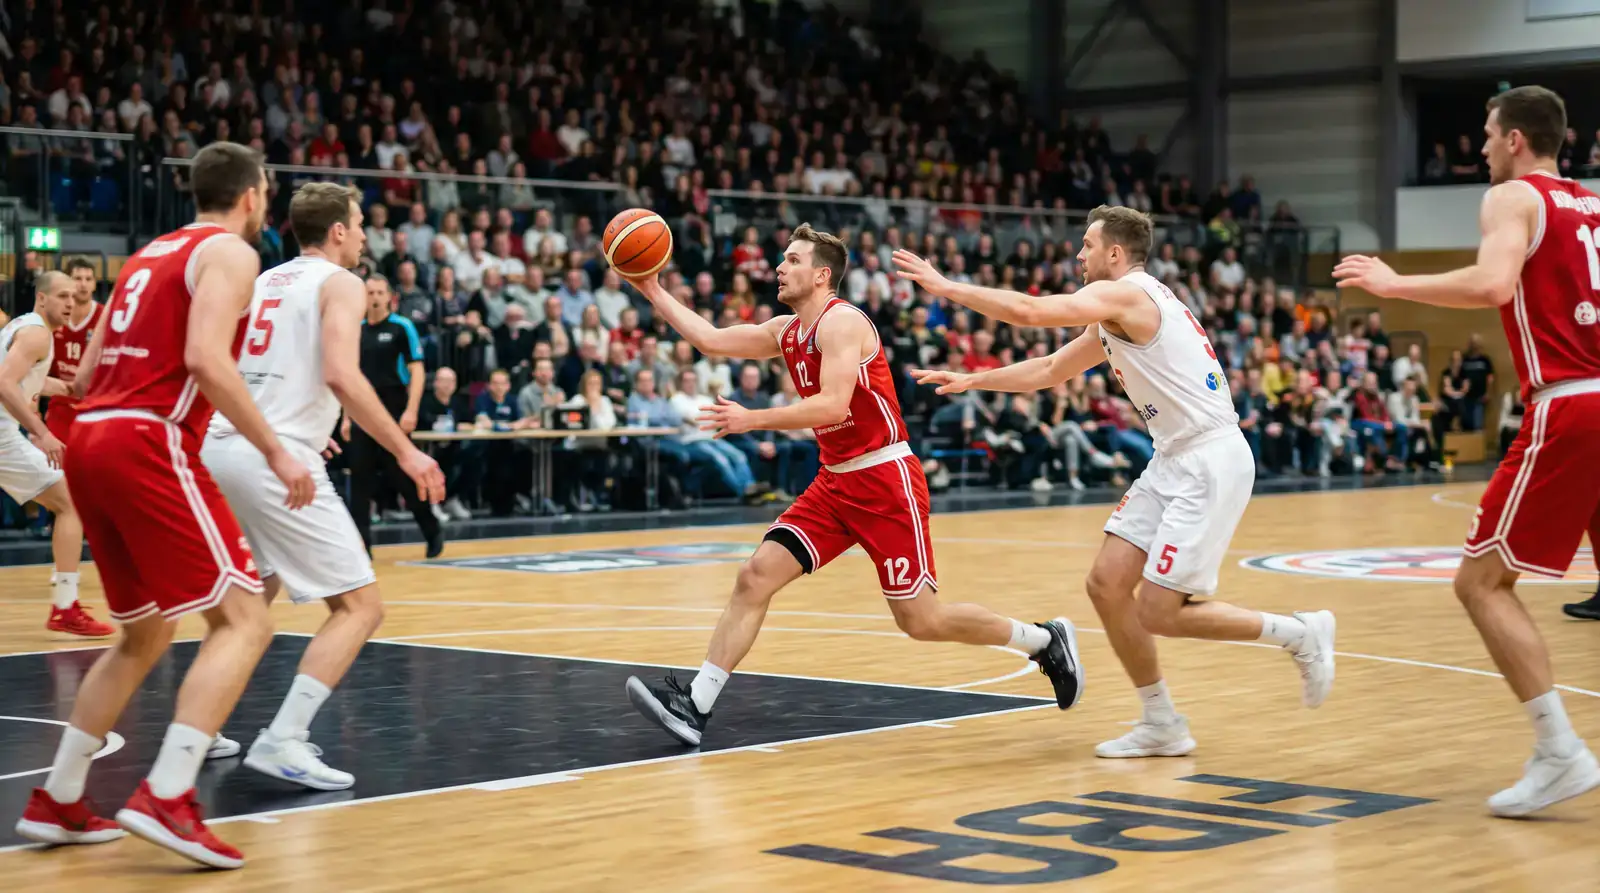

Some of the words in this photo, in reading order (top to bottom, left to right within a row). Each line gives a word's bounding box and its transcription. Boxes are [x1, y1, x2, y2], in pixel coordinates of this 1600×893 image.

[1575, 223, 1600, 291] 1
[110, 267, 152, 333] 3
[247, 298, 282, 356] 5
[65, 341, 81, 360] 19
[796, 360, 814, 388] 12
[883, 556, 912, 586] 12
[1156, 543, 1178, 575] 5
[762, 773, 1440, 885] FIBA
